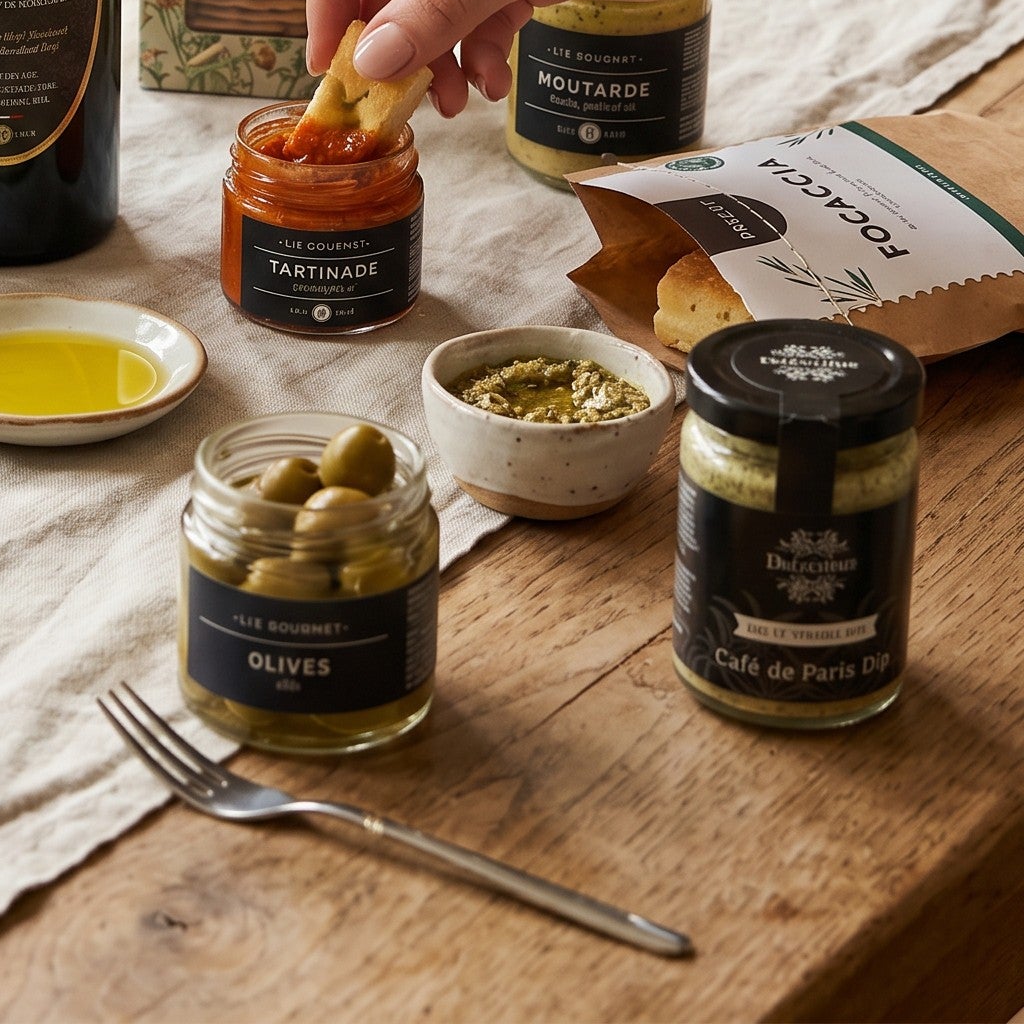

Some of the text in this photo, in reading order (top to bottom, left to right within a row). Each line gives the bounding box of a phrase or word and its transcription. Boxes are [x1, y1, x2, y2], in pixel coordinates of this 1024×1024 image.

[538, 71, 650, 98] MOUTARDE
[758, 157, 911, 260] FOCACCIA
[285, 239, 303, 250] LIE
[269, 259, 378, 280] TARTINADE
[247, 650, 331, 677] OLIVES
[715, 647, 890, 681] Café de Paris Dip
